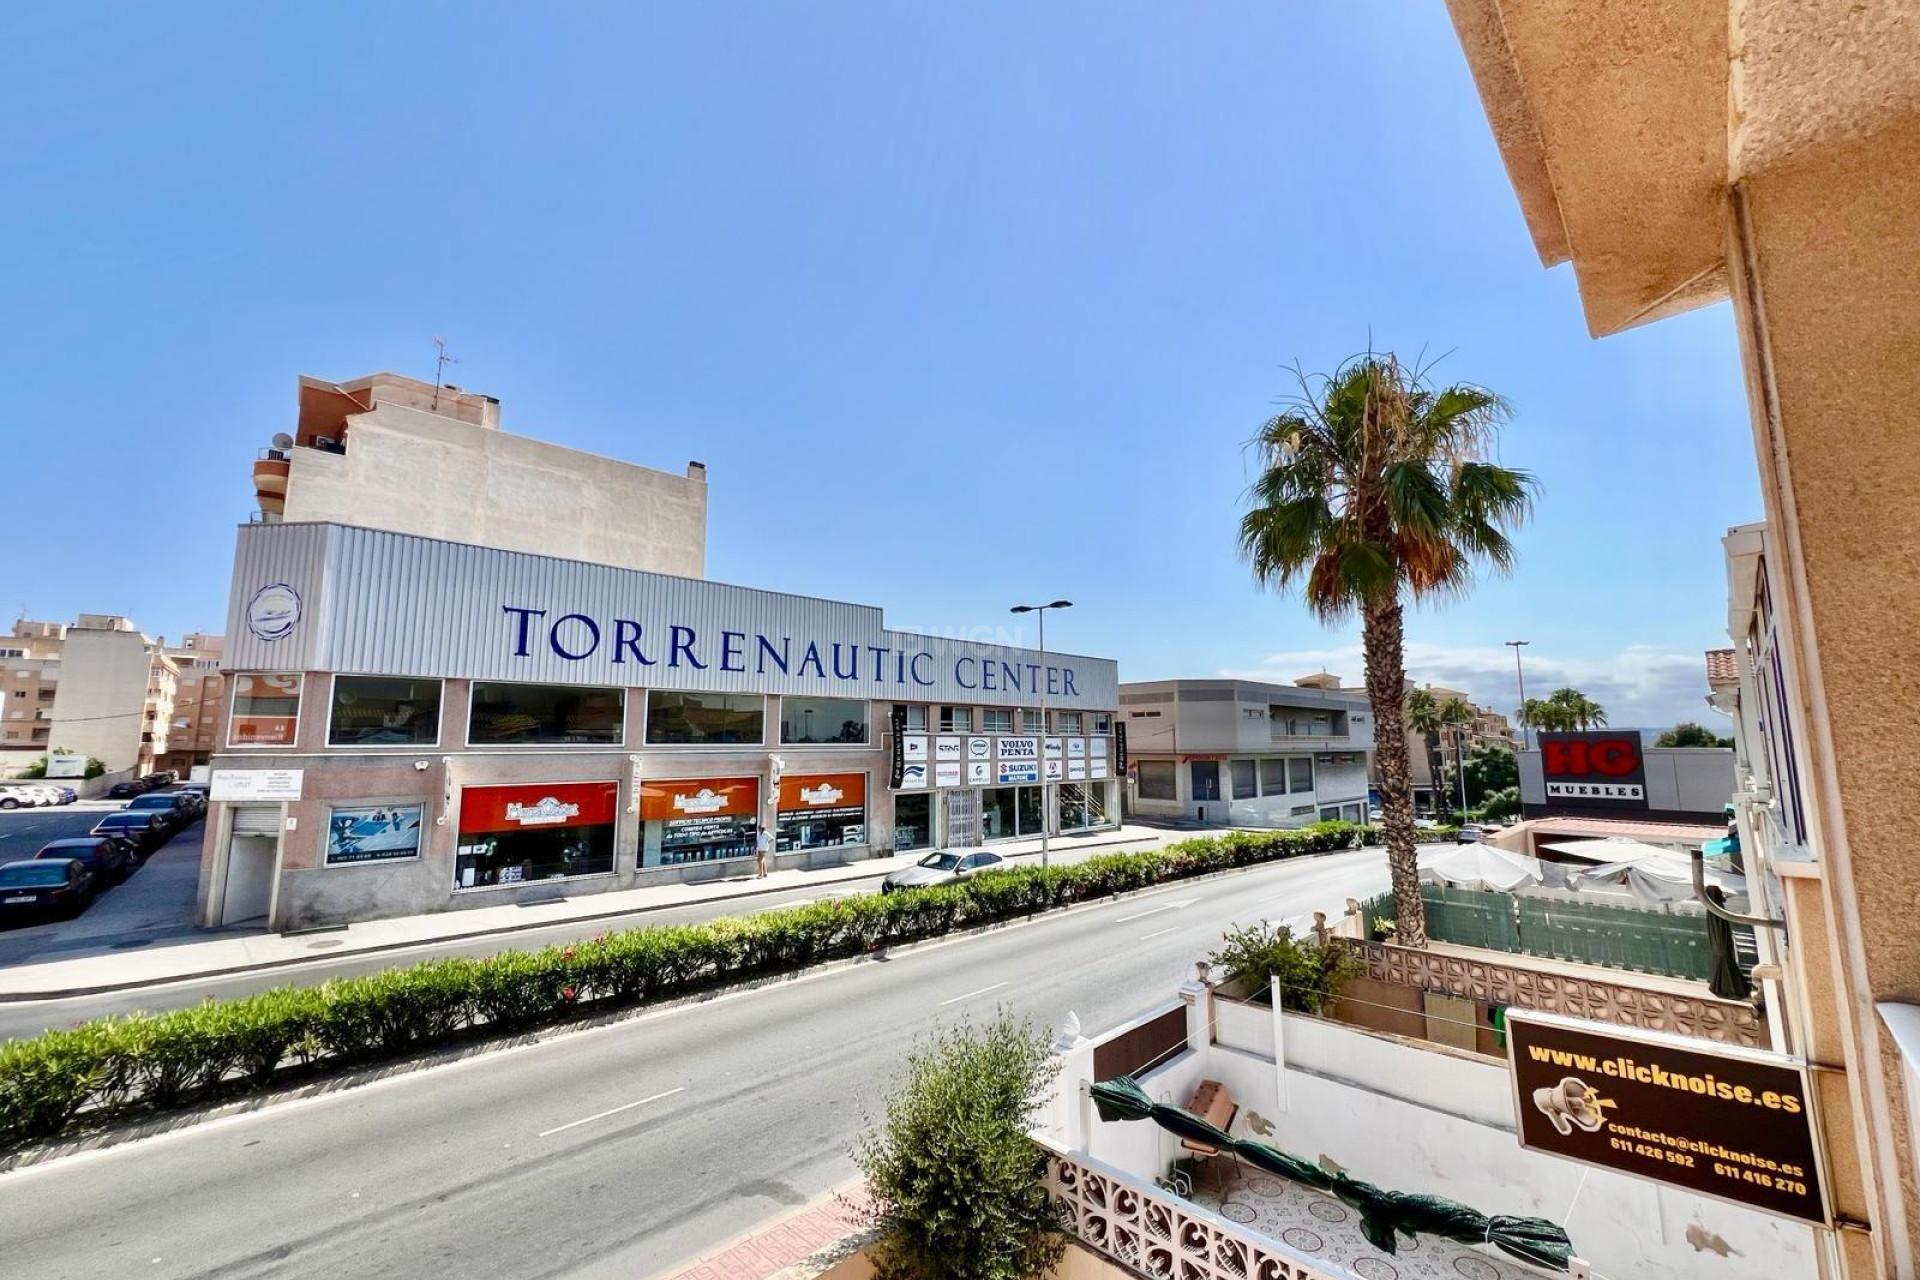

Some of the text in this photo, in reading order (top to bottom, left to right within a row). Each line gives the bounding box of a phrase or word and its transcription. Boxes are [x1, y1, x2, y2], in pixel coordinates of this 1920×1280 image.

[503, 605, 1080, 696] TORRENAUTIC CENTER
[1001, 748, 1035, 756] PENTA
[1008, 764, 1037, 773] SUZUKI
[1543, 740, 1640, 776] HG
[1550, 785, 1639, 796] MUEBLES
[1528, 1045, 1801, 1113] www.clicknoise.es
[1608, 1122, 1804, 1178] contacto@clicknoise.es
[1610, 1137, 1807, 1196] 611 426 592 611 416 270
